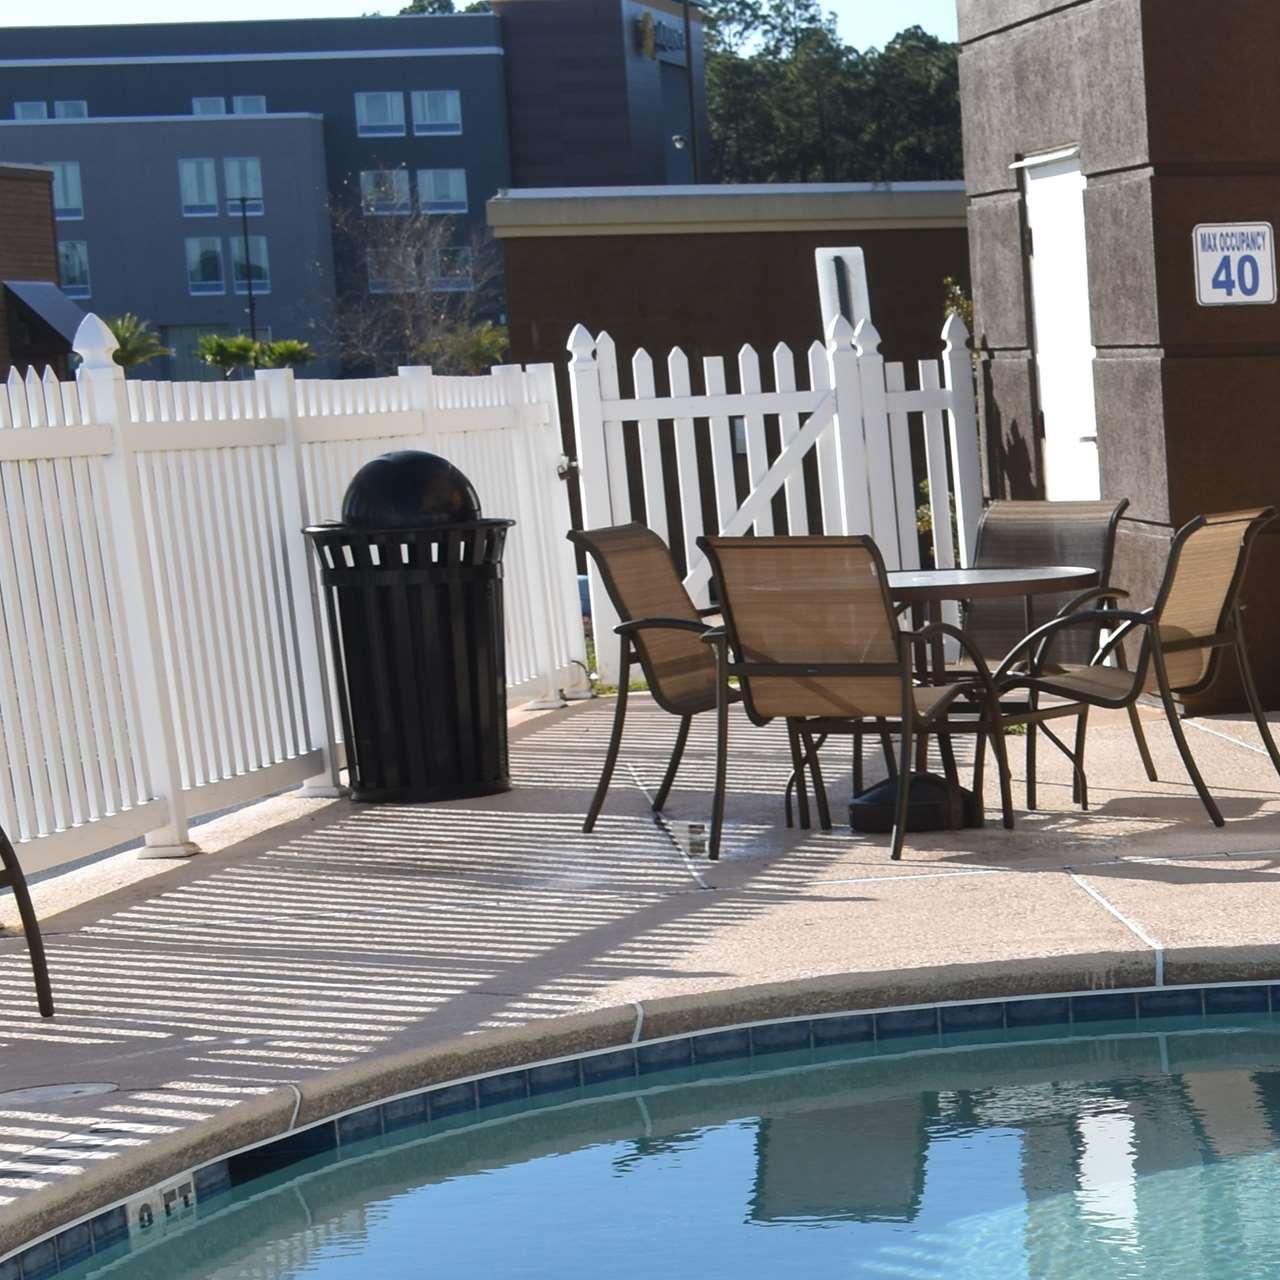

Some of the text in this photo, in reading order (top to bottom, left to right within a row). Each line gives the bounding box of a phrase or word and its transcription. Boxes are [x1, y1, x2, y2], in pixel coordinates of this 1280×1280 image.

[1200, 231, 1266, 252] MAX OCCUPANCY
[1212, 254, 1260, 296] 40
